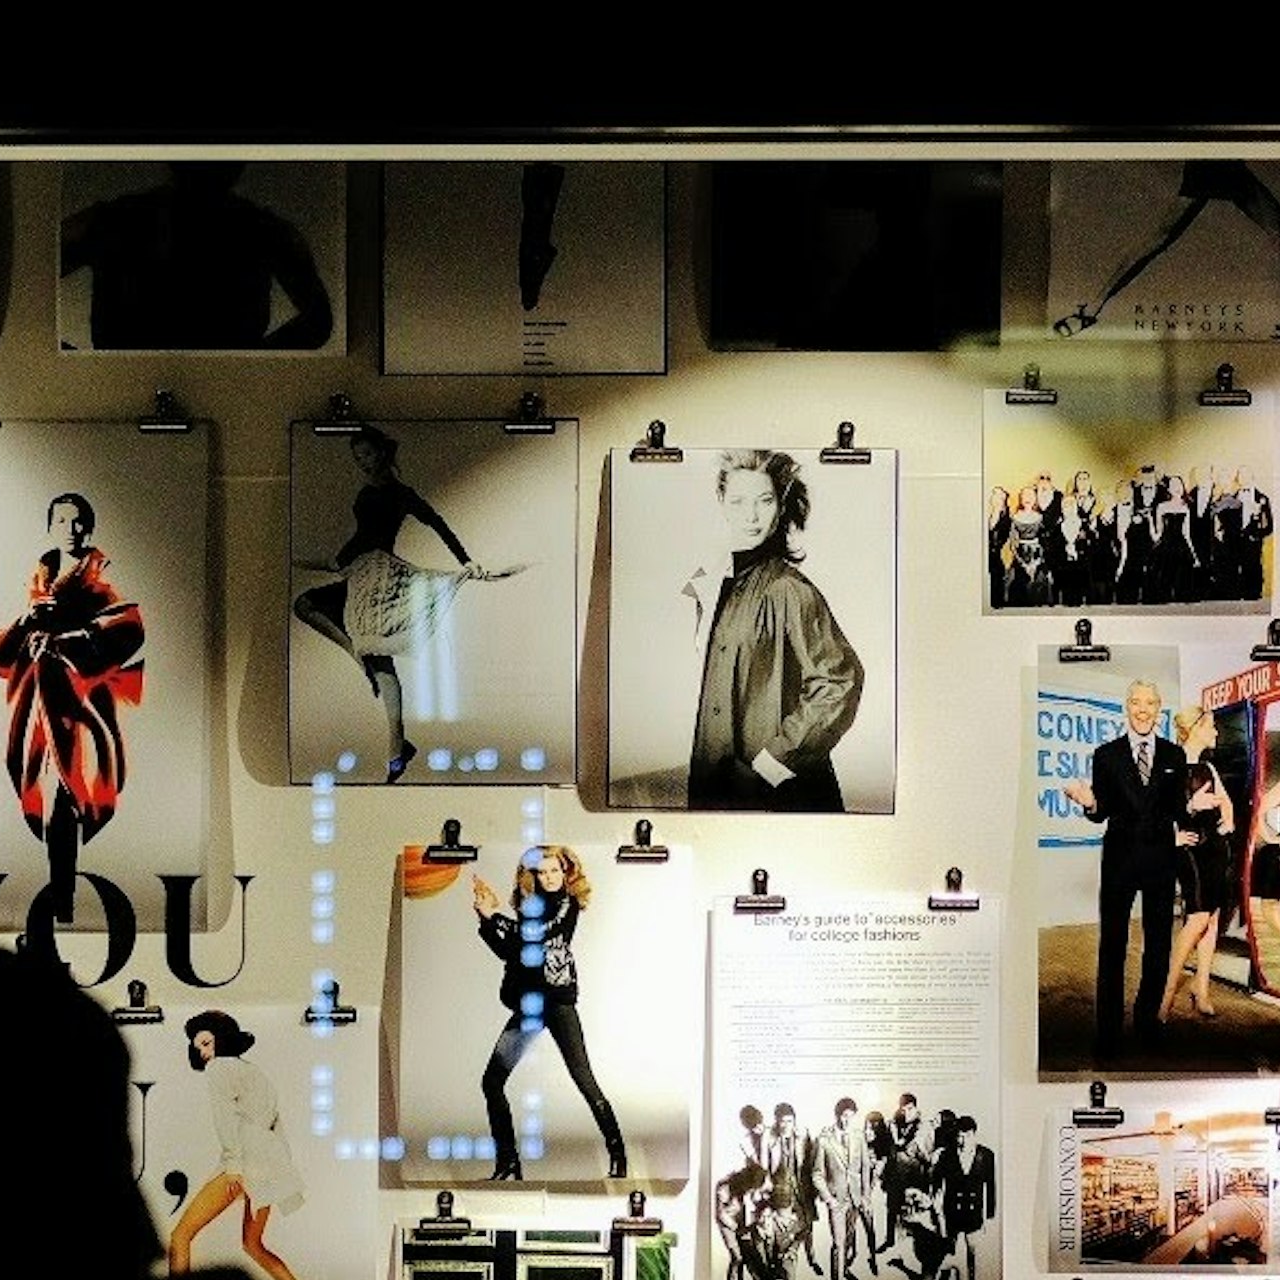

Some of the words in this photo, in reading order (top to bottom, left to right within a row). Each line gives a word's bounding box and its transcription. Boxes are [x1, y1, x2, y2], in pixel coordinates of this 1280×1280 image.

[1134, 304, 1243, 316] BARNEYS
[1204, 679, 1232, 709] KEEP
[1238, 664, 1270, 699] YOUR
[814, 913, 851, 928] guide
[810, 929, 859, 943] college
[865, 928, 921, 941] fashions
[1058, 1125, 1076, 1251] CONNOISSEUR
